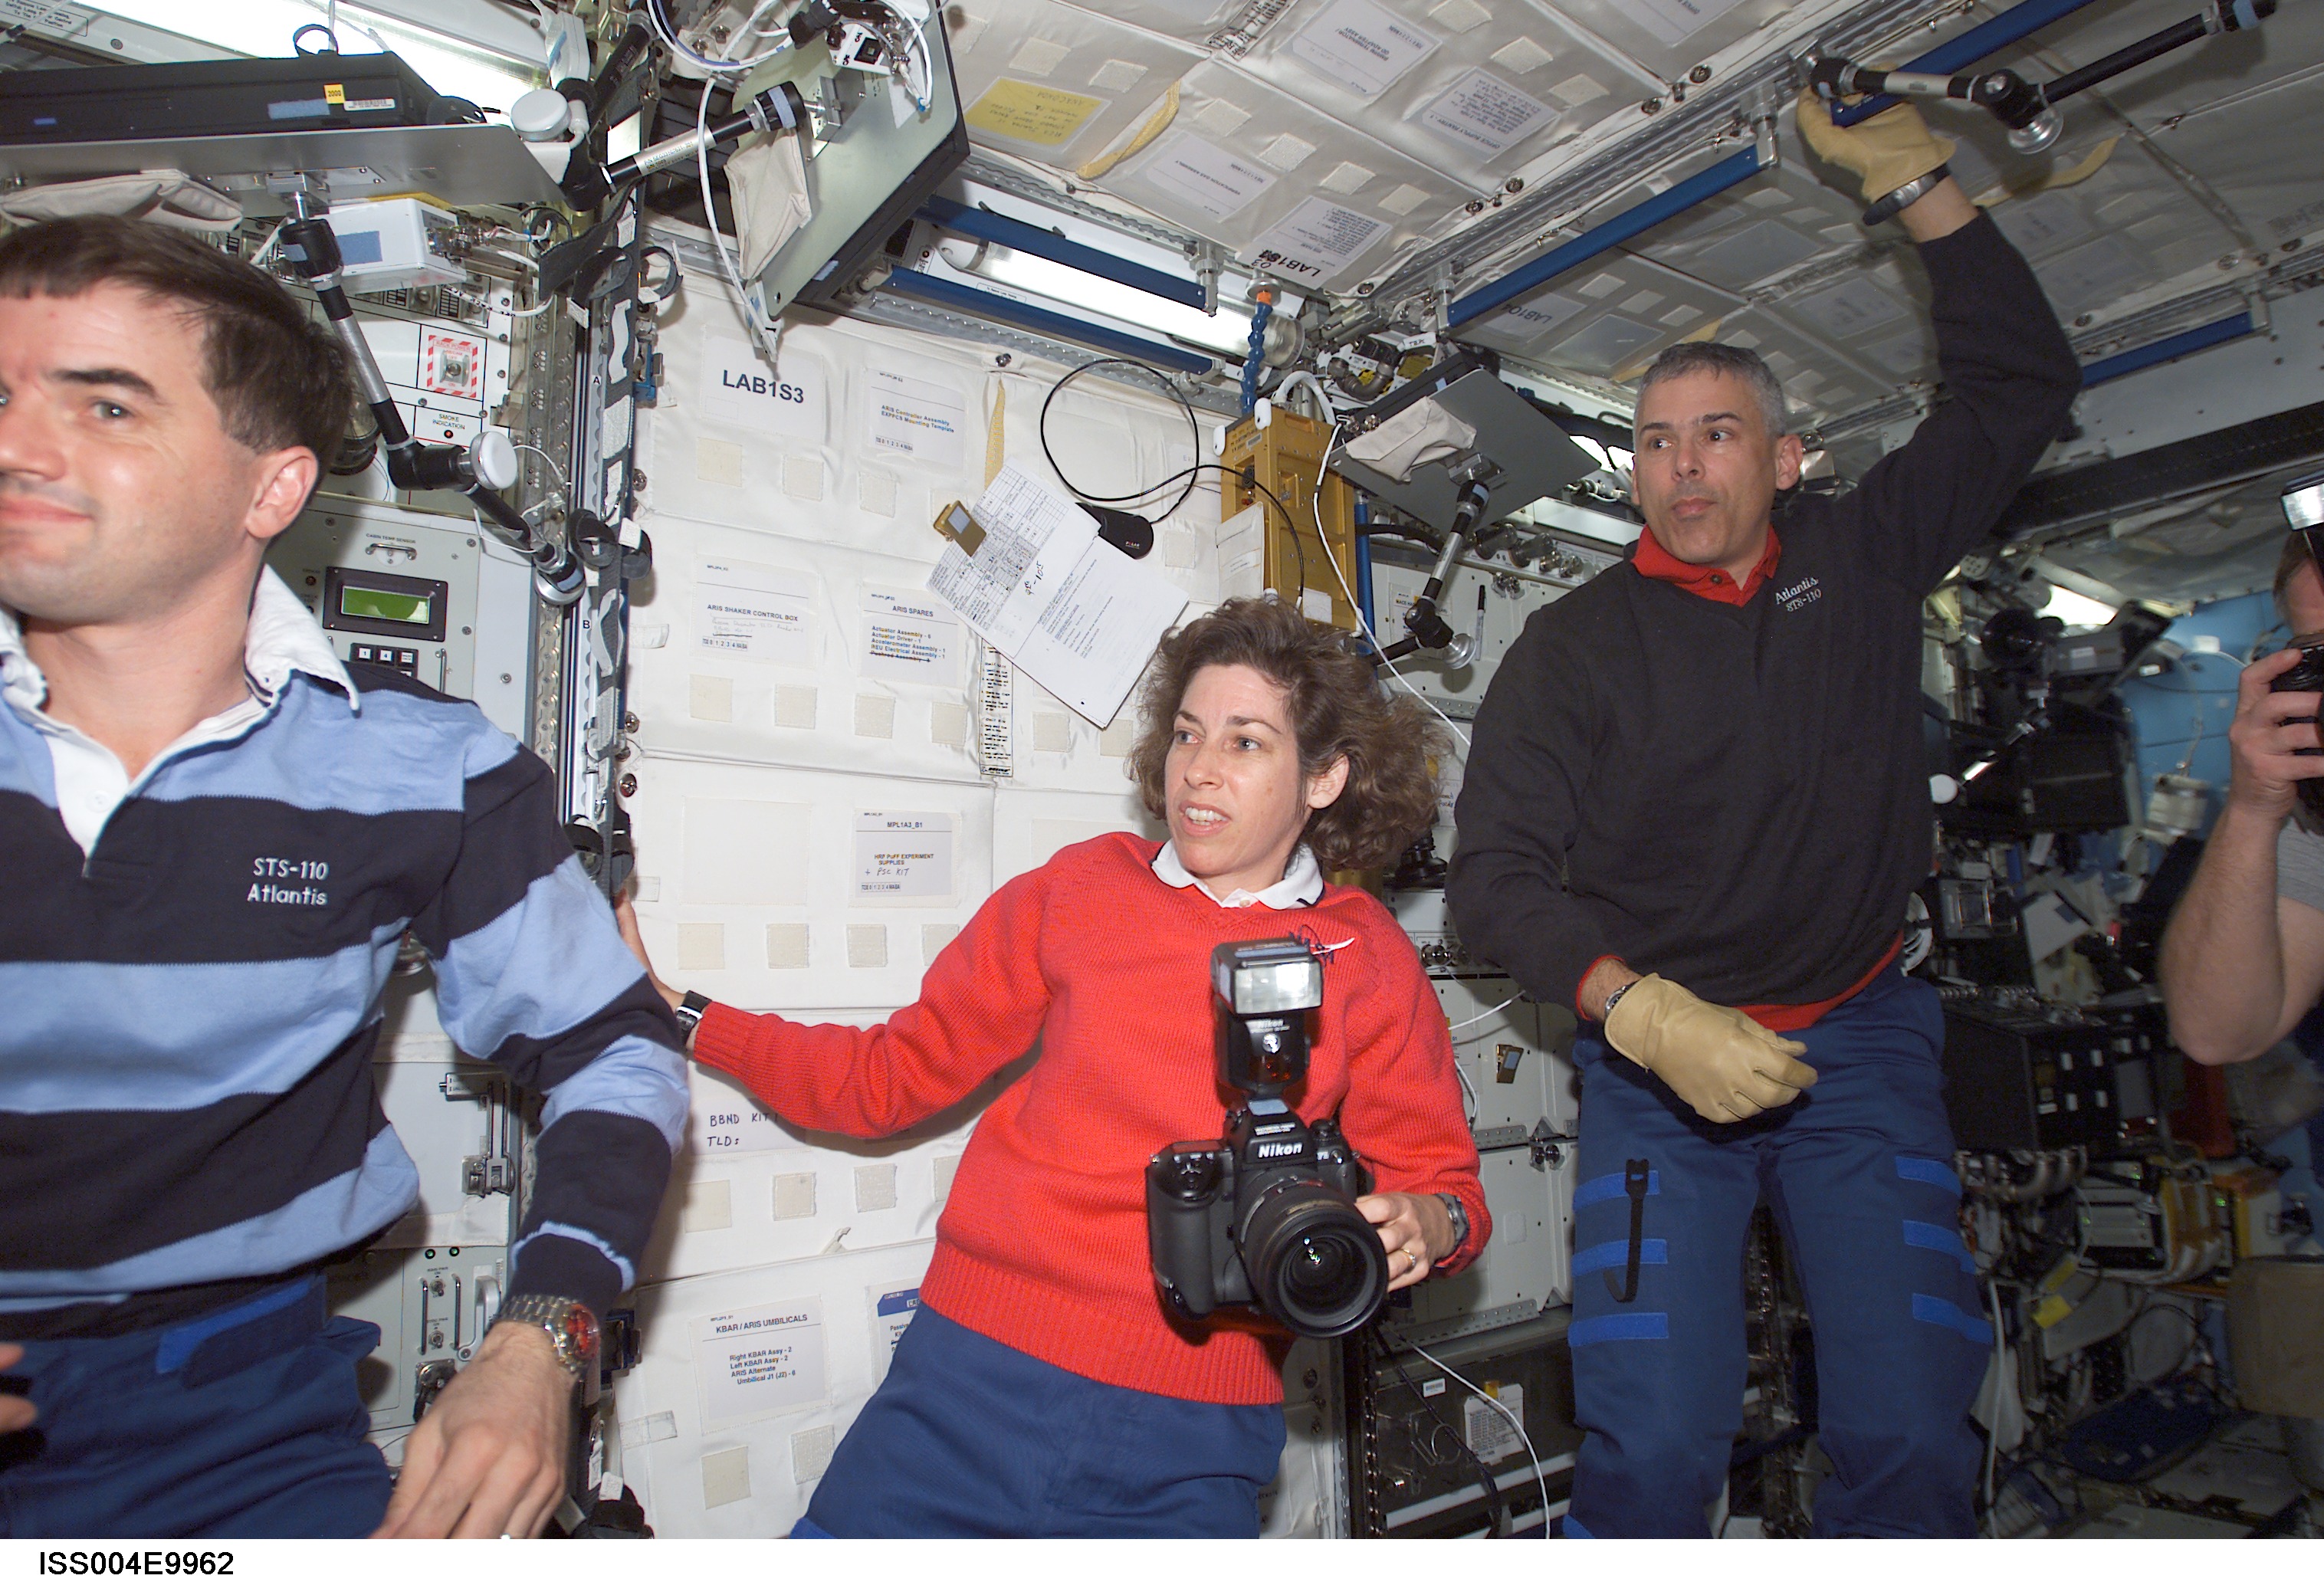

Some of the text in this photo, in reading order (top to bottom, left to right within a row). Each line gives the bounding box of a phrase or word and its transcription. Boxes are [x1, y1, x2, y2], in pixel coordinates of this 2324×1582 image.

[593, 376, 600, 385] A
[724, 369, 804, 403] LAB1S3
[1775, 576, 1820, 606] Atlantis
[1787, 589, 1823, 612] STS-110
[753, 610, 783, 619] CONTROL
[909, 609, 934, 617] SPARES
[583, 619, 591, 629] B
[897, 629, 923, 638] Assembly
[871, 638, 911, 648] Accelerometer
[912, 644, 937, 653] Assembly
[912, 650, 937, 659] Assembly
[253, 858, 330, 881] STS-110
[896, 868, 909, 876] KIT
[247, 883, 328, 907] Atlantis
[751, 1113, 770, 1122] KIT
[707, 1136, 740, 1147] TLDs
[1258, 1142, 1303, 1159] Nikon
[716, 1324, 738, 1334] KBAR
[743, 1321, 761, 1330] ARIS
[763, 1314, 808, 1327] UMBILICALS
[748, 1350, 766, 1358] KBAR
[744, 1358, 763, 1367] KBAR
[748, 1366, 776, 1375] Alternate
[737, 1375, 766, 1385] Umbilical
